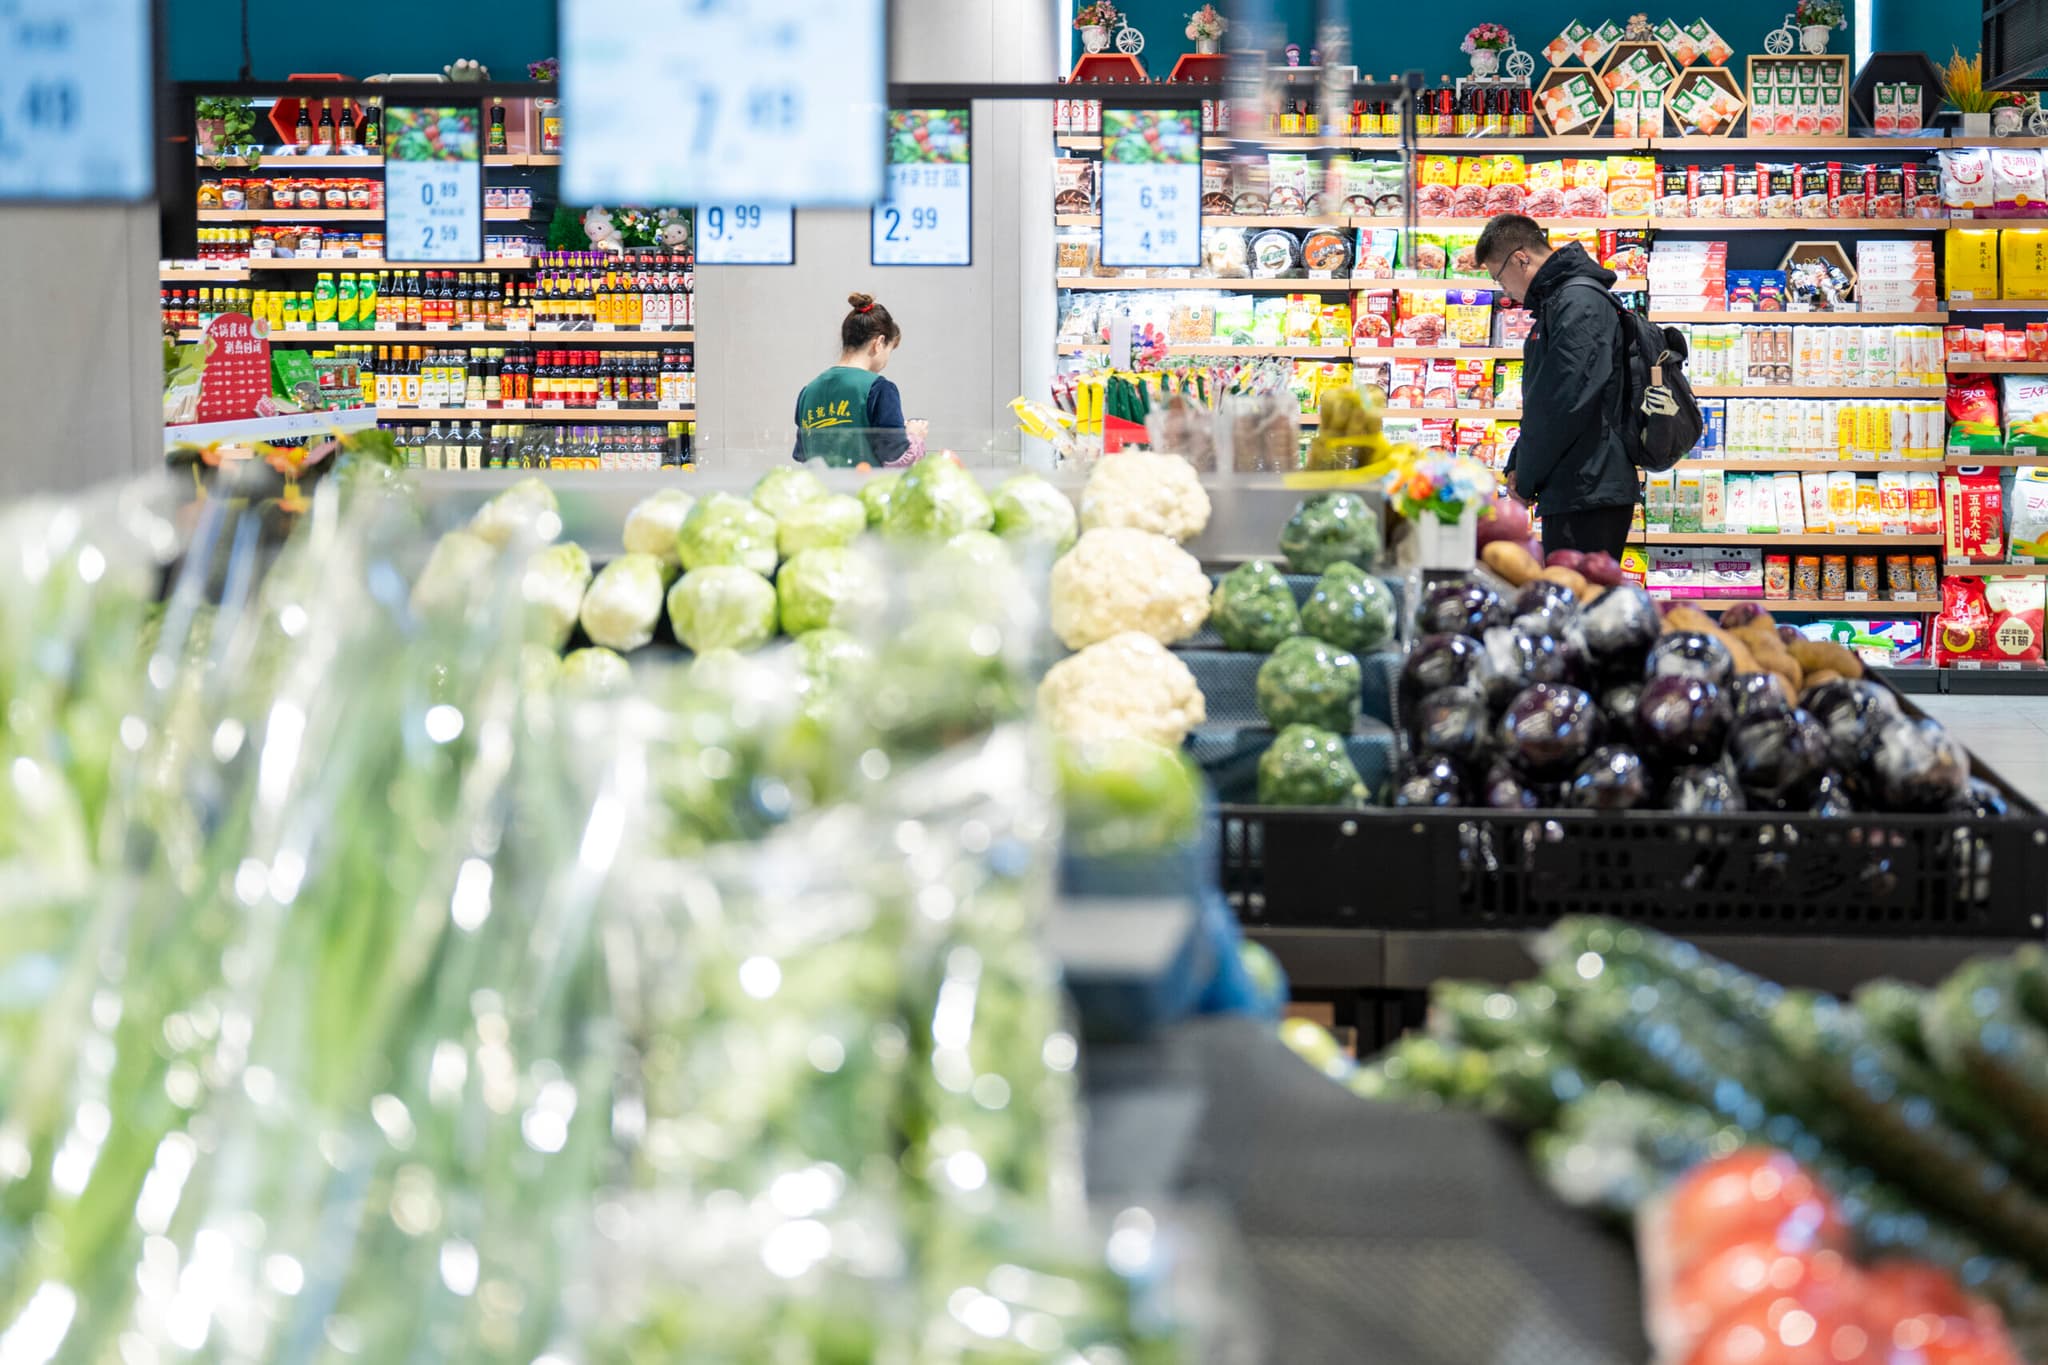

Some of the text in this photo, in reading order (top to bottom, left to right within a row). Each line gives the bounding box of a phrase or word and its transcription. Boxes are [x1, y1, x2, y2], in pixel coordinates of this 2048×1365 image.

[708, 204, 761, 241] 9.99
[885, 206, 938, 242] 2.99
[209, 322, 248, 338] 火锅食材
[1968, 494, 1981, 541] 五常大米
